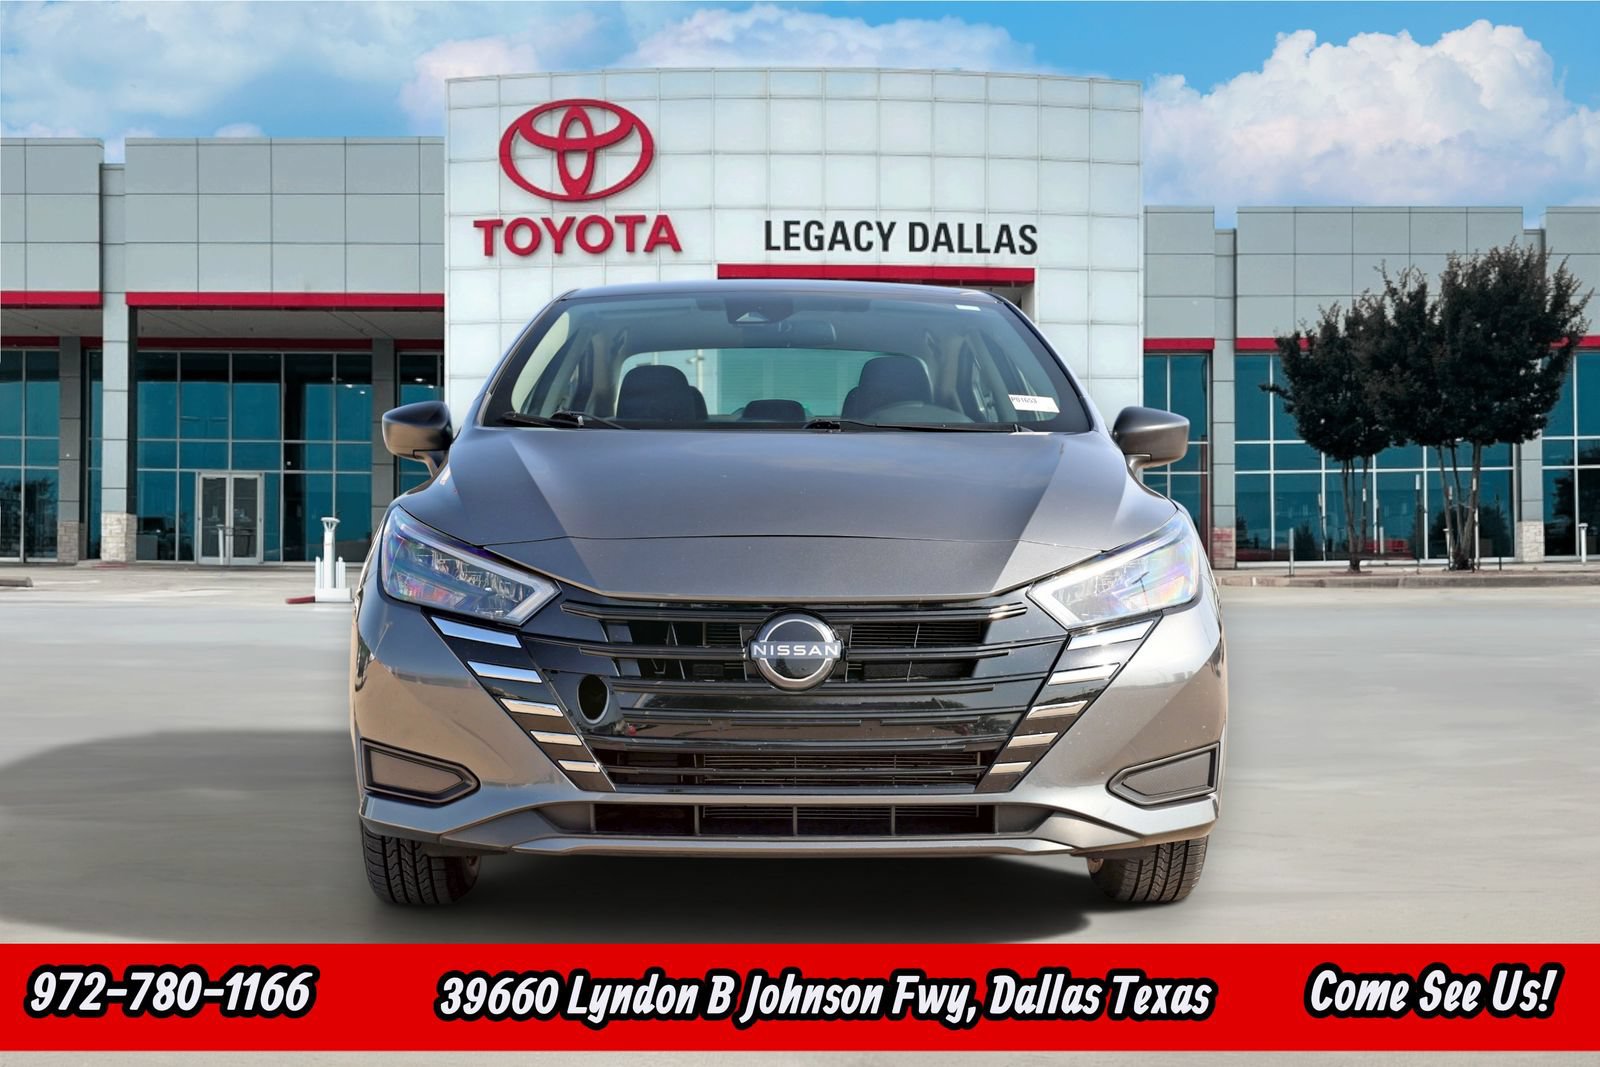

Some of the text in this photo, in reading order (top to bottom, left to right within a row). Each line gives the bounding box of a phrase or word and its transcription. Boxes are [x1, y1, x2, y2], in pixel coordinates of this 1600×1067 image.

[475, 214, 682, 256] TOYOTA
[765, 220, 1038, 255] LEGACY DALLAS
[752, 644, 839, 657] NISSAN
